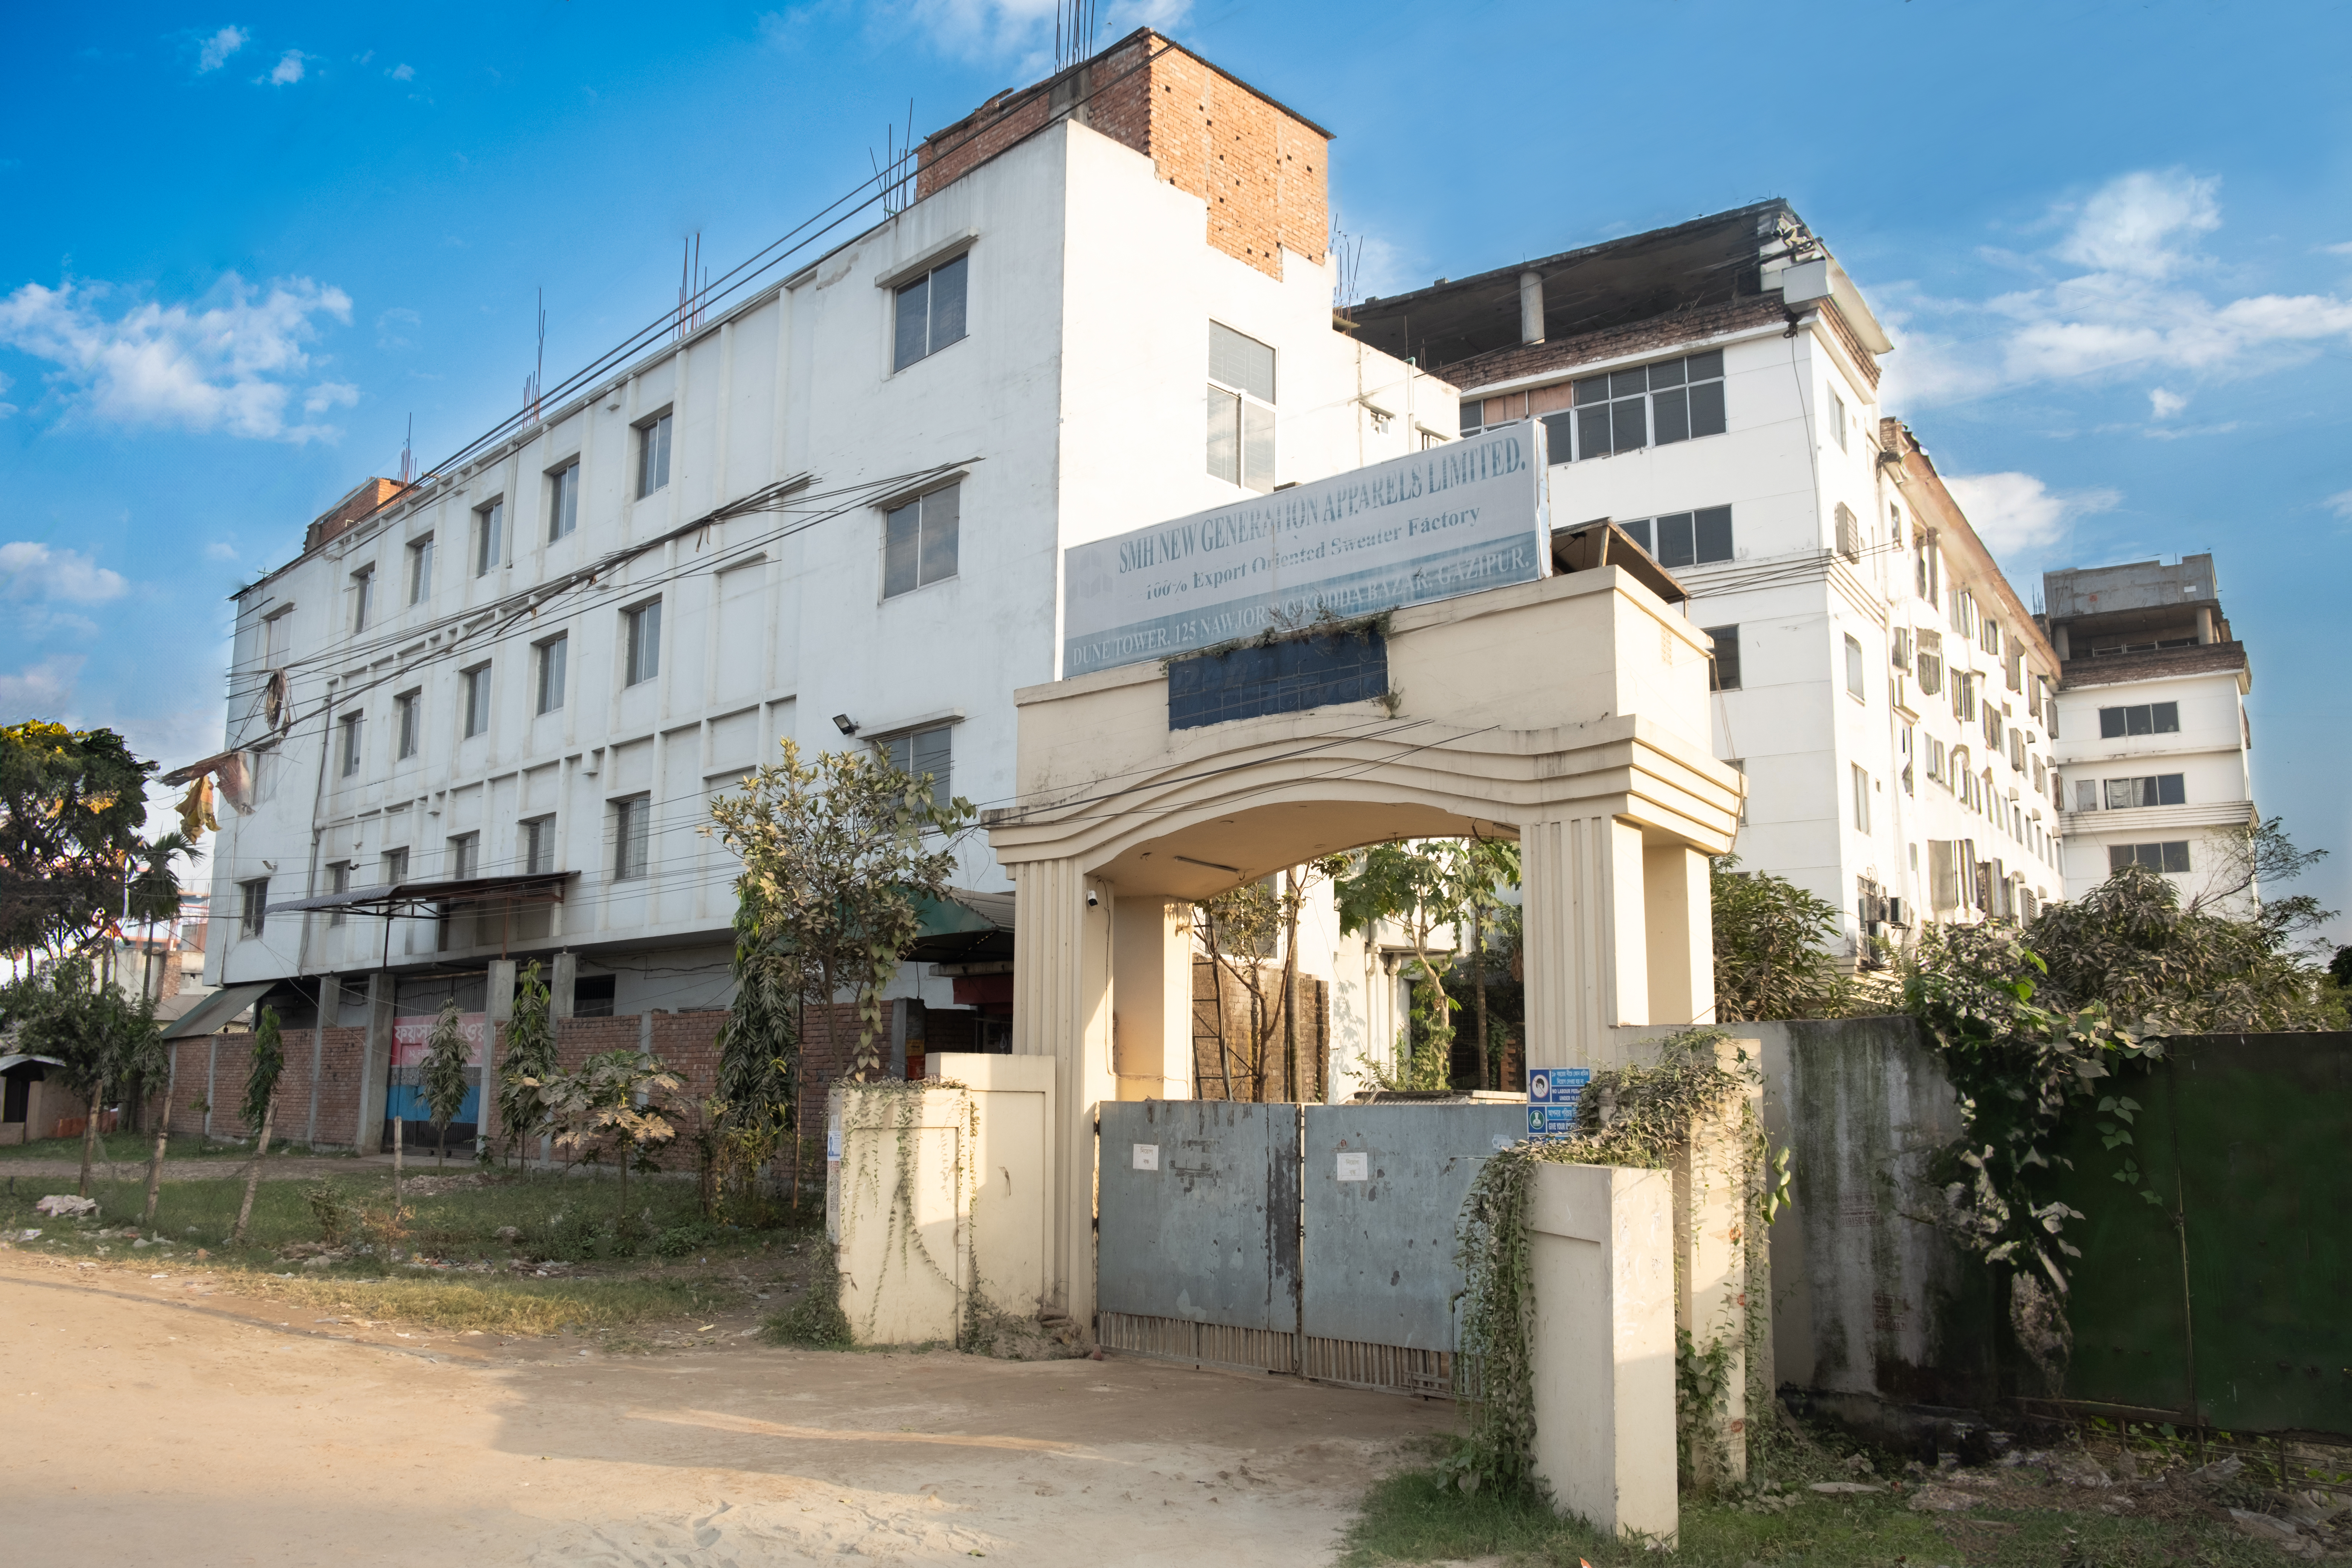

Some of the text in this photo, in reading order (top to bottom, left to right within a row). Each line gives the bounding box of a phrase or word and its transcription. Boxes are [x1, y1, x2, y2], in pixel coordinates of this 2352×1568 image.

[1119, 437, 1525, 574] SMH NEW GENERATION APPARELS LIMITED.
[1193, 562, 1247, 589] Export
[1253, 542, 1325, 573] Oriented
[1331, 527, 1402, 555] Sweater
[1408, 507, 1480, 537] Factory
[1073, 642, 1110, 666] DUNE
[1114, 628, 1171, 656] TOWER,
[1175, 620, 1196, 643] 125
[1200, 605, 1266, 637] NAWJOR
[1438, 547, 1529, 585] GAZIPUR.
